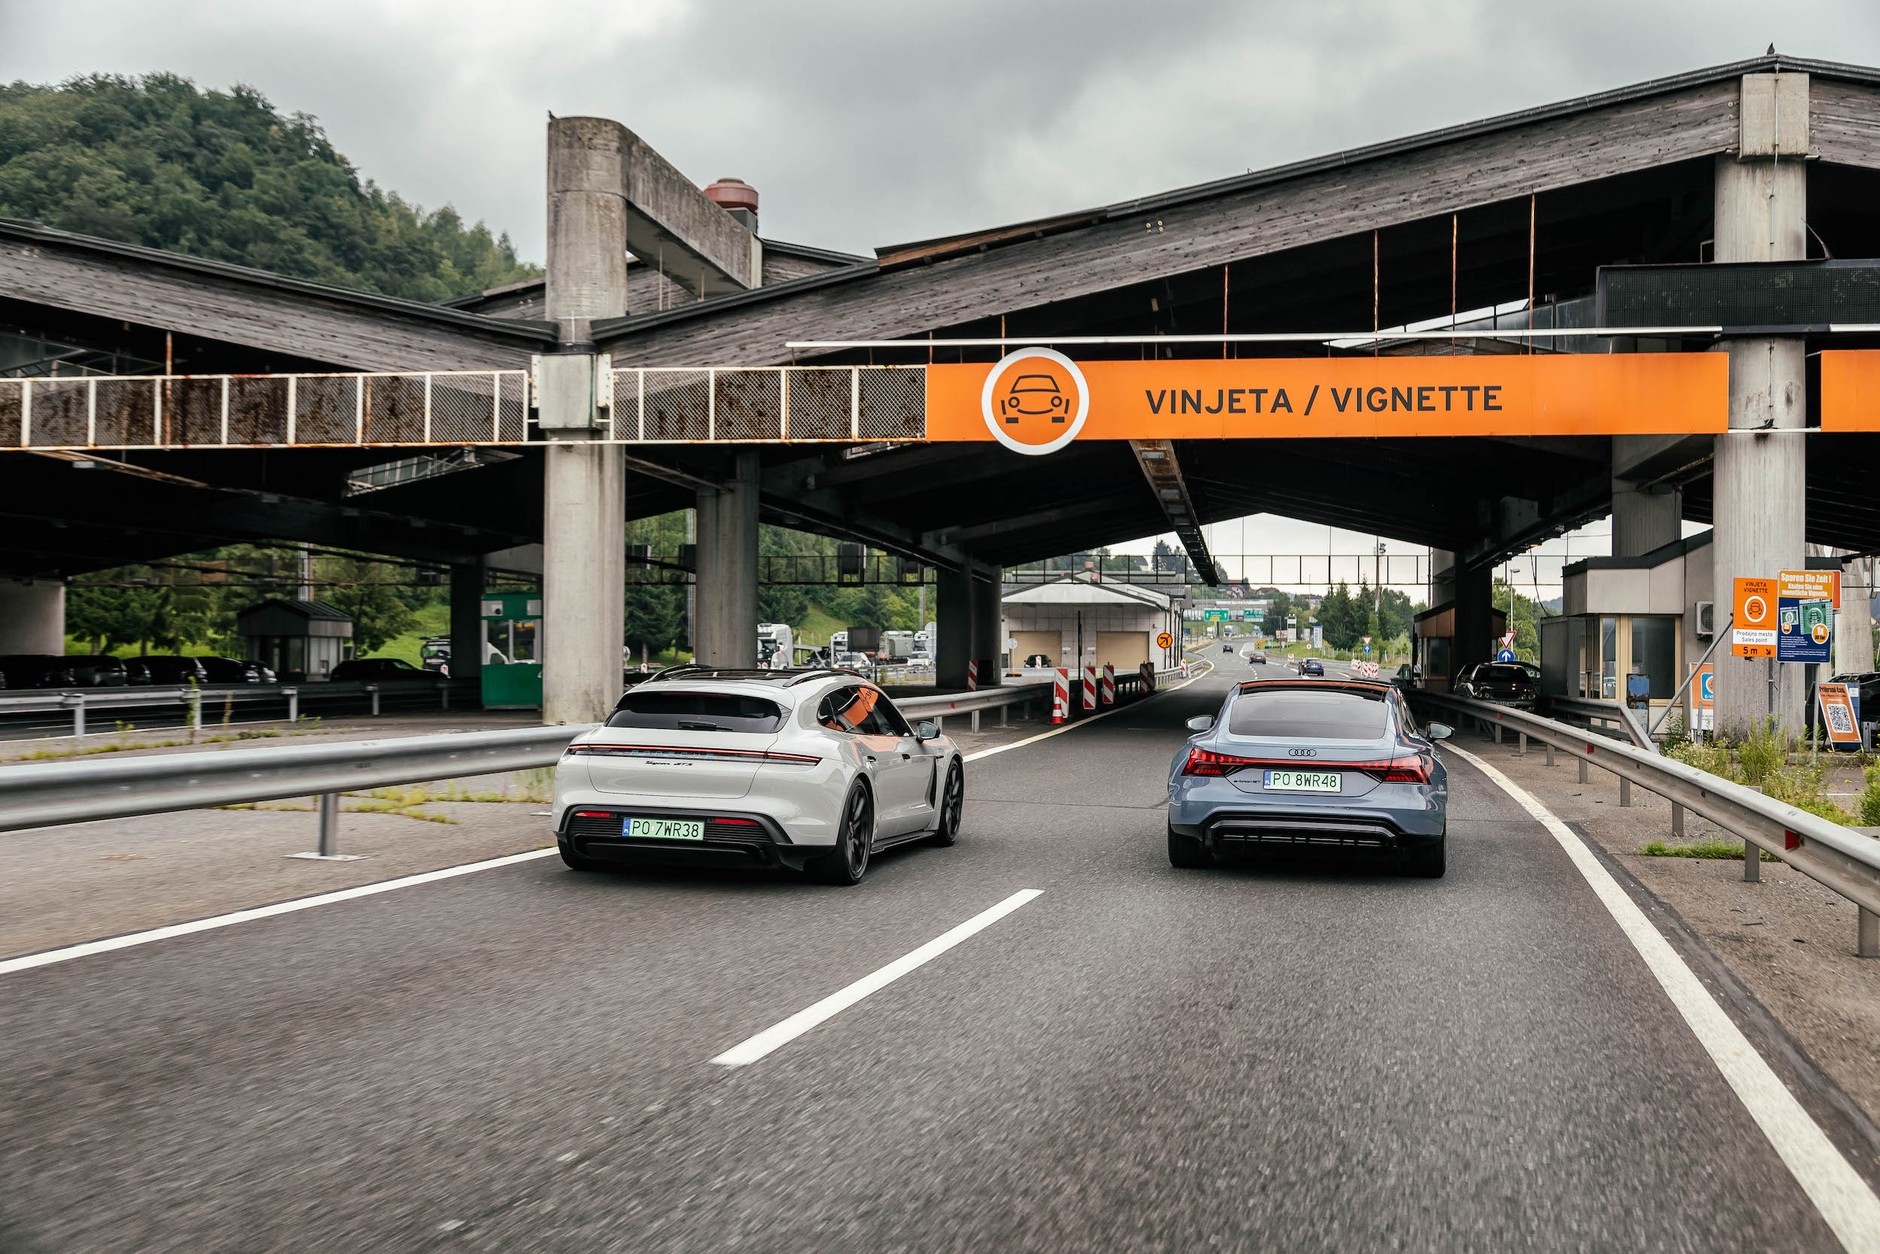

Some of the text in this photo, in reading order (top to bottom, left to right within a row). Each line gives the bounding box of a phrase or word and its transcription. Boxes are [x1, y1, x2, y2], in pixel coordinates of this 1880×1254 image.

[1145, 385, 1503, 416] VINJETA / VIGNETTE
[1781, 573, 1804, 582] Sparen
[1805, 574, 1815, 582] Sie
[1816, 575, 1828, 583] Zeit
[1274, 773, 1337, 788] PO 8WR48
[632, 821, 699, 838] PO 7WR38
